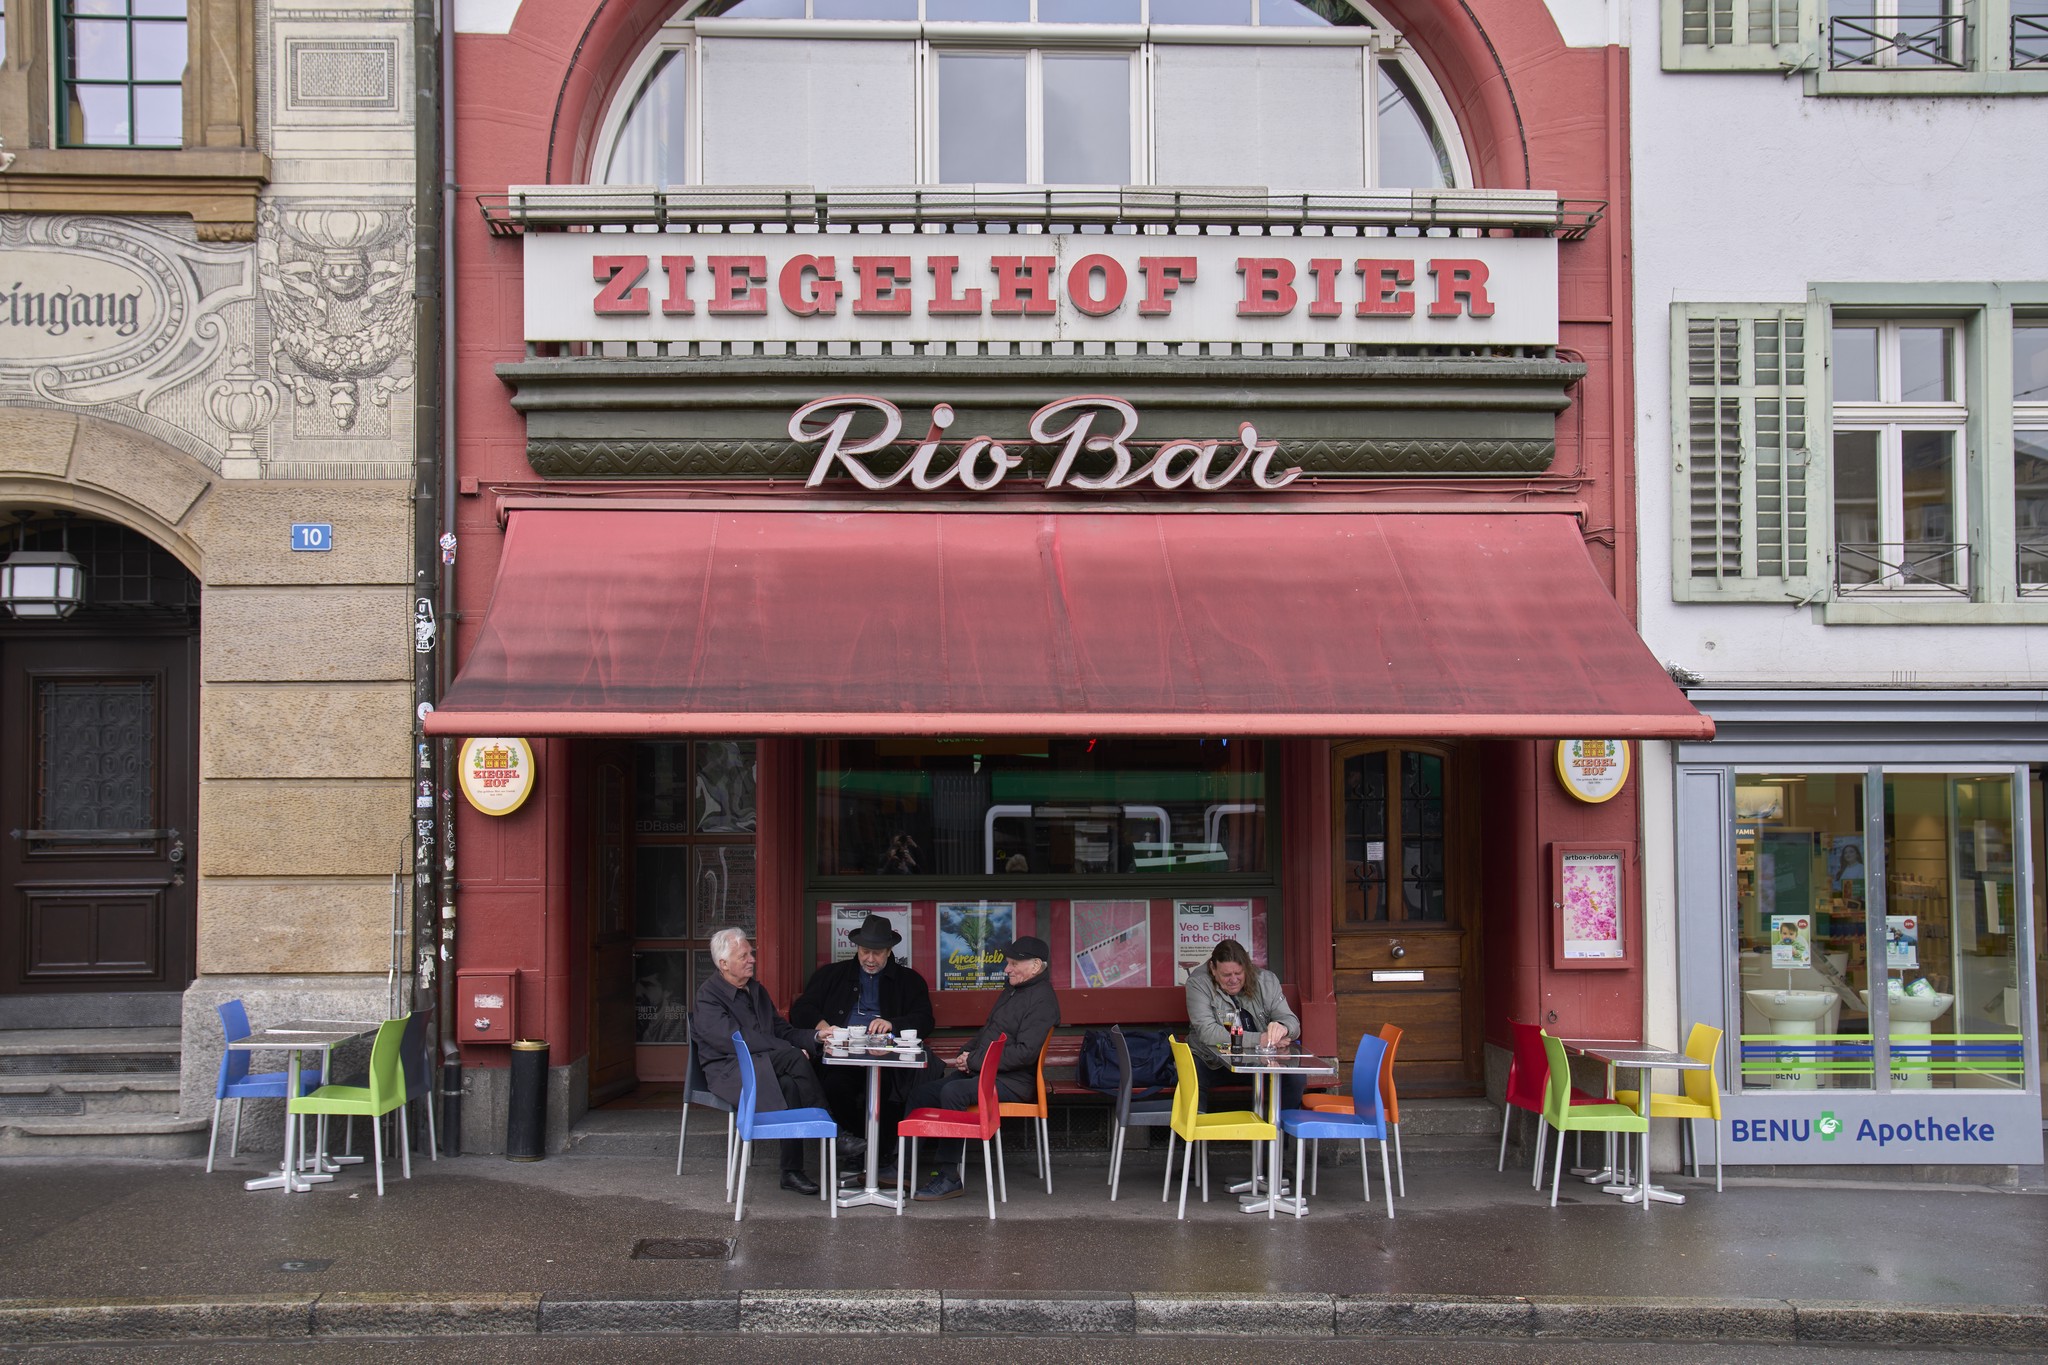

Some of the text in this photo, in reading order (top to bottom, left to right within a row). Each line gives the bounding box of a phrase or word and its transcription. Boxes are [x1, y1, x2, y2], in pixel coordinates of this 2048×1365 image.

[593, 254, 1495, 318] ZIEGELHOF BIER
[787, 394, 1303, 491] Rio Bar
[302, 528, 322, 546] 10
[1572, 759, 1616, 767] ZIEGEL
[473, 770, 520, 779] ZIEGEL
[1582, 767, 1607, 776] HOF
[483, 779, 510, 788] HOF
[1179, 921, 1241, 931] Veo E-Bikes
[837, 928, 849, 937] Ve
[1180, 933, 1190, 942] in
[1192, 933, 1210, 942] the
[838, 938, 847, 948] in
[1731, 1117, 1996, 1147] BENU Apotheke
